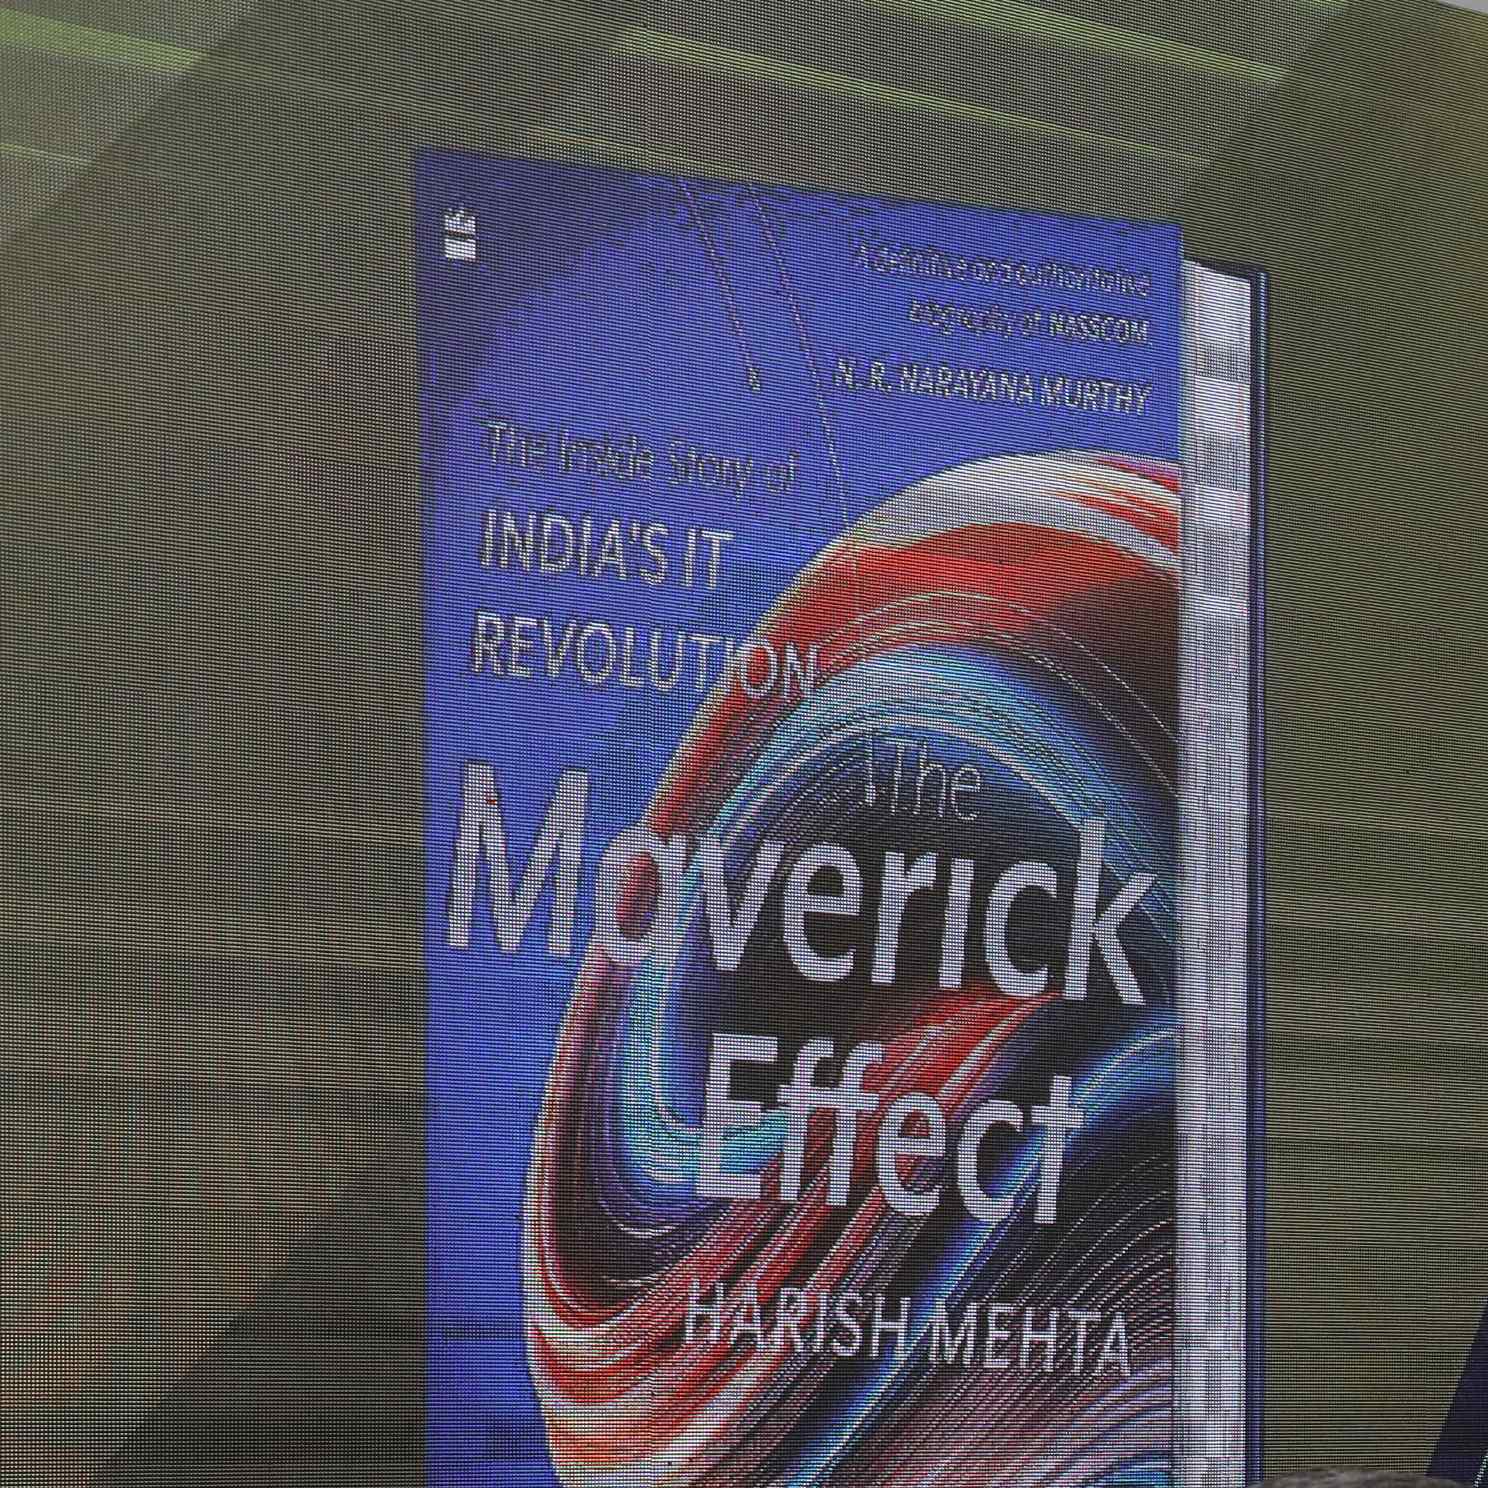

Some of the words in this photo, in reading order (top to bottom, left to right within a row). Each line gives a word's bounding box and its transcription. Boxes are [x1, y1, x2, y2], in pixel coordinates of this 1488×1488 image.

[870, 360, 893, 393] R.
[900, 363, 1034, 404] NARAYANA
[1040, 377, 1153, 417] MURTHY
[486, 420, 548, 477] The
[556, 430, 655, 484] Inside
[668, 437, 754, 500] Story
[762, 448, 801, 495] of
[482, 508, 667, 586] INDIA'S
[680, 530, 737, 592] IT
[471, 609, 823, 702] REVOLUTION
[876, 740, 983, 820] The
[445, 762, 1157, 1008] Maverick
[696, 1033, 1089, 1225] Effect
[682, 1276, 909, 1361] HARISH
[929, 1301, 1132, 1377] MEHTA
